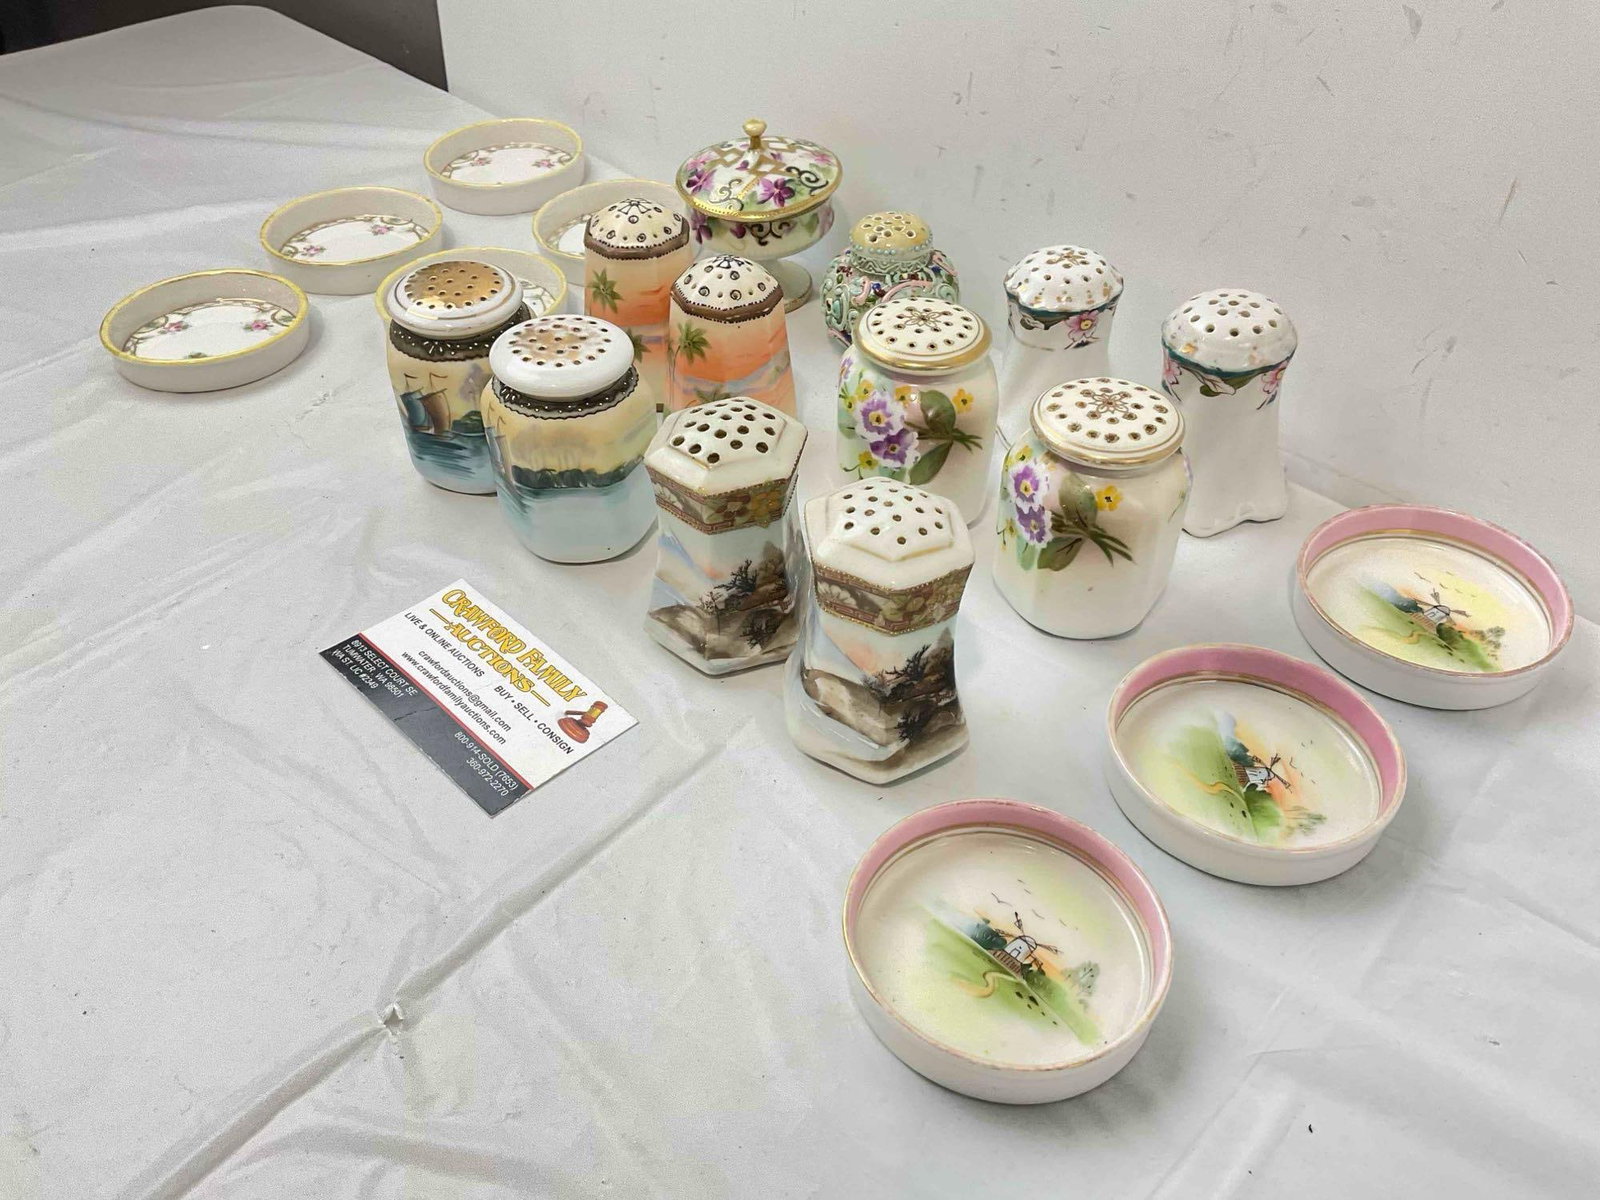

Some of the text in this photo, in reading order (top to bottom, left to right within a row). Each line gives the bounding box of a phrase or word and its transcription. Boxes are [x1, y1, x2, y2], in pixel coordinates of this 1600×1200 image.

[349, 664, 363, 675] LIC
[364, 650, 389, 671] SELECT
[385, 668, 409, 688] COURT
[405, 686, 418, 696] SE
[375, 672, 388, 684] WA
[404, 612, 423, 626] LIVE
[425, 628, 452, 650] ONLINE
[448, 647, 485, 678] AUCTIONS
[442, 589, 588, 702] CRAWFORD FAMILY
[443, 622, 535, 692] AUCTIONS
[401, 651, 506, 745] www.crawfordfamilyauctions.com
[418, 650, 512, 732] crawfordauctions@gmail.com
[494, 685, 574, 755] BUY SELL CONSIGN
[454, 731, 519, 791] 800-914-SOLD (7653)
[466, 757, 509, 797] 360-972-2270
